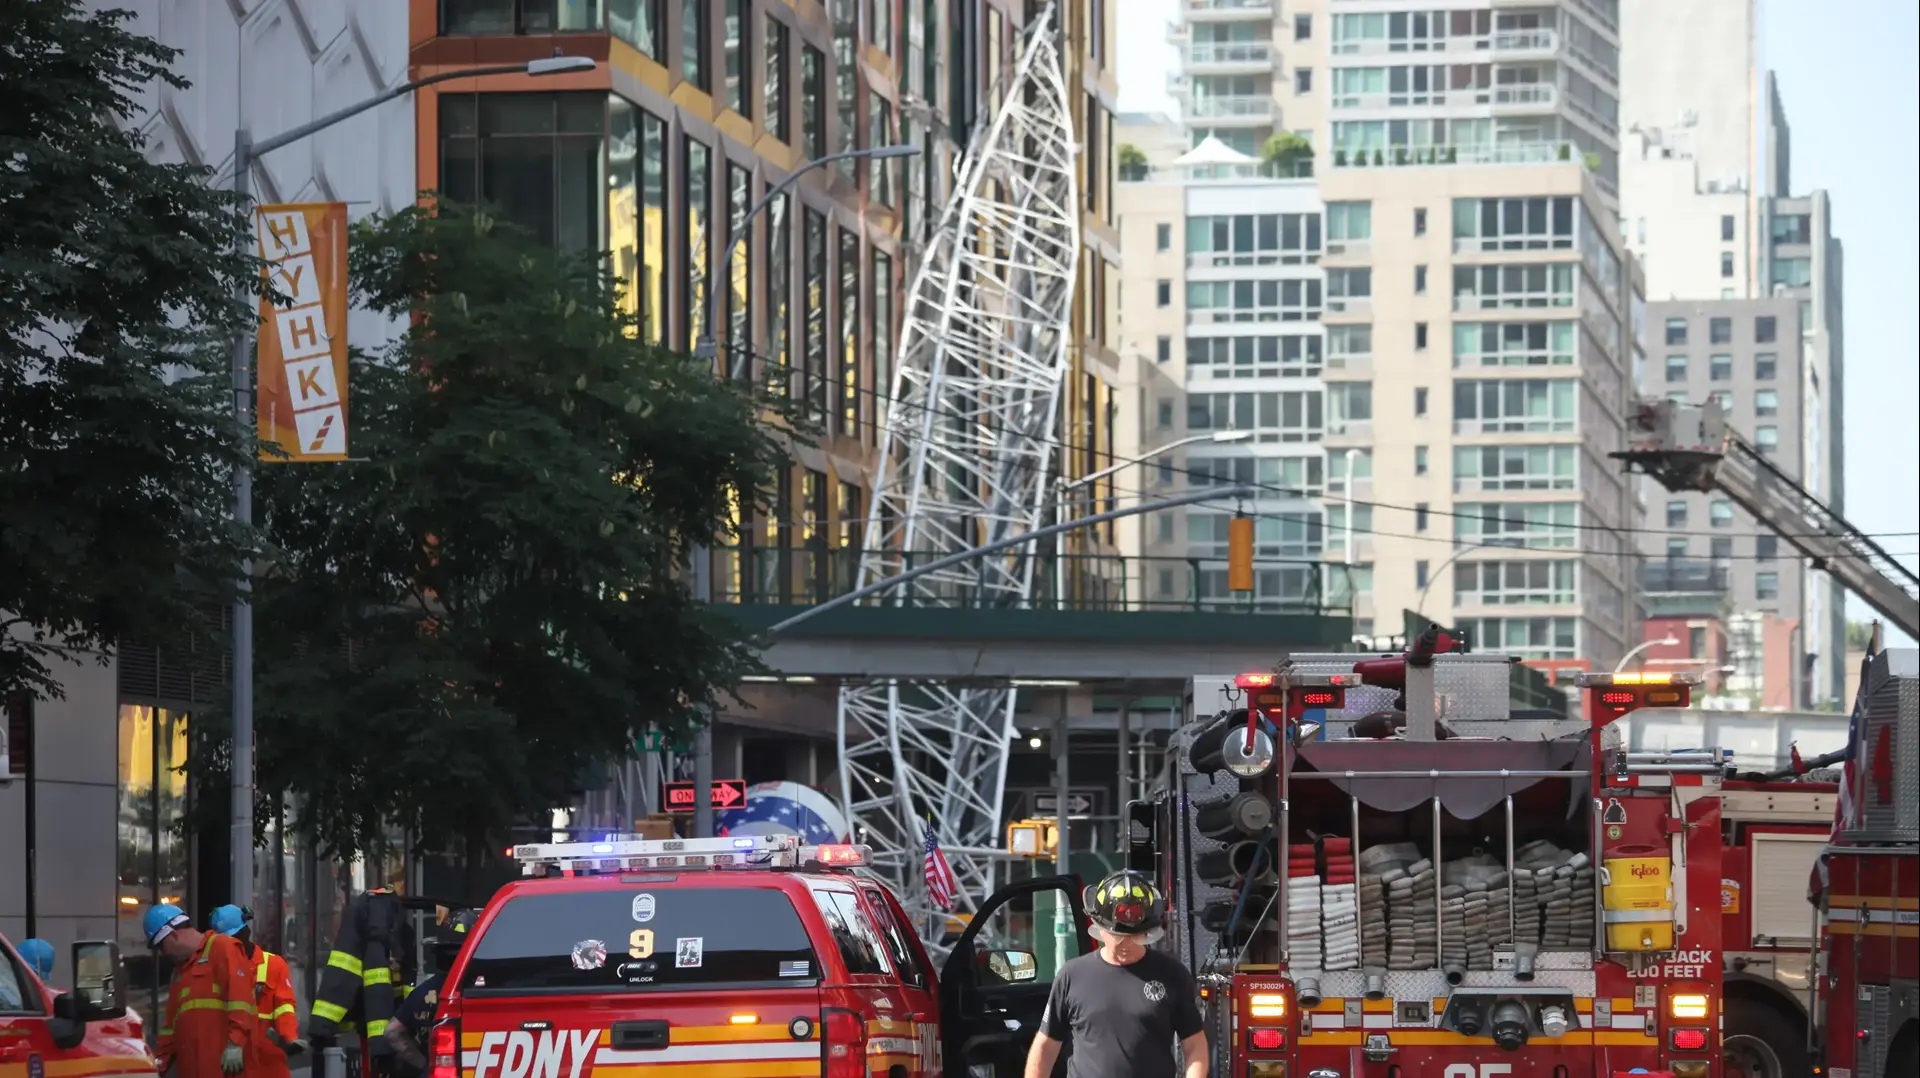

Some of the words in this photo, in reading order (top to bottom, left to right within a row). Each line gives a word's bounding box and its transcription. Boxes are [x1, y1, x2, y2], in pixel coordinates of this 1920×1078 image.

[676, 790, 693, 801] ON
[1630, 864, 1660, 879] igloo
[629, 929, 654, 959] 9
[1663, 965, 1704, 978] FEET
[1249, 982, 1285, 990] SP13002H
[474, 1029, 601, 1078] FDNY
